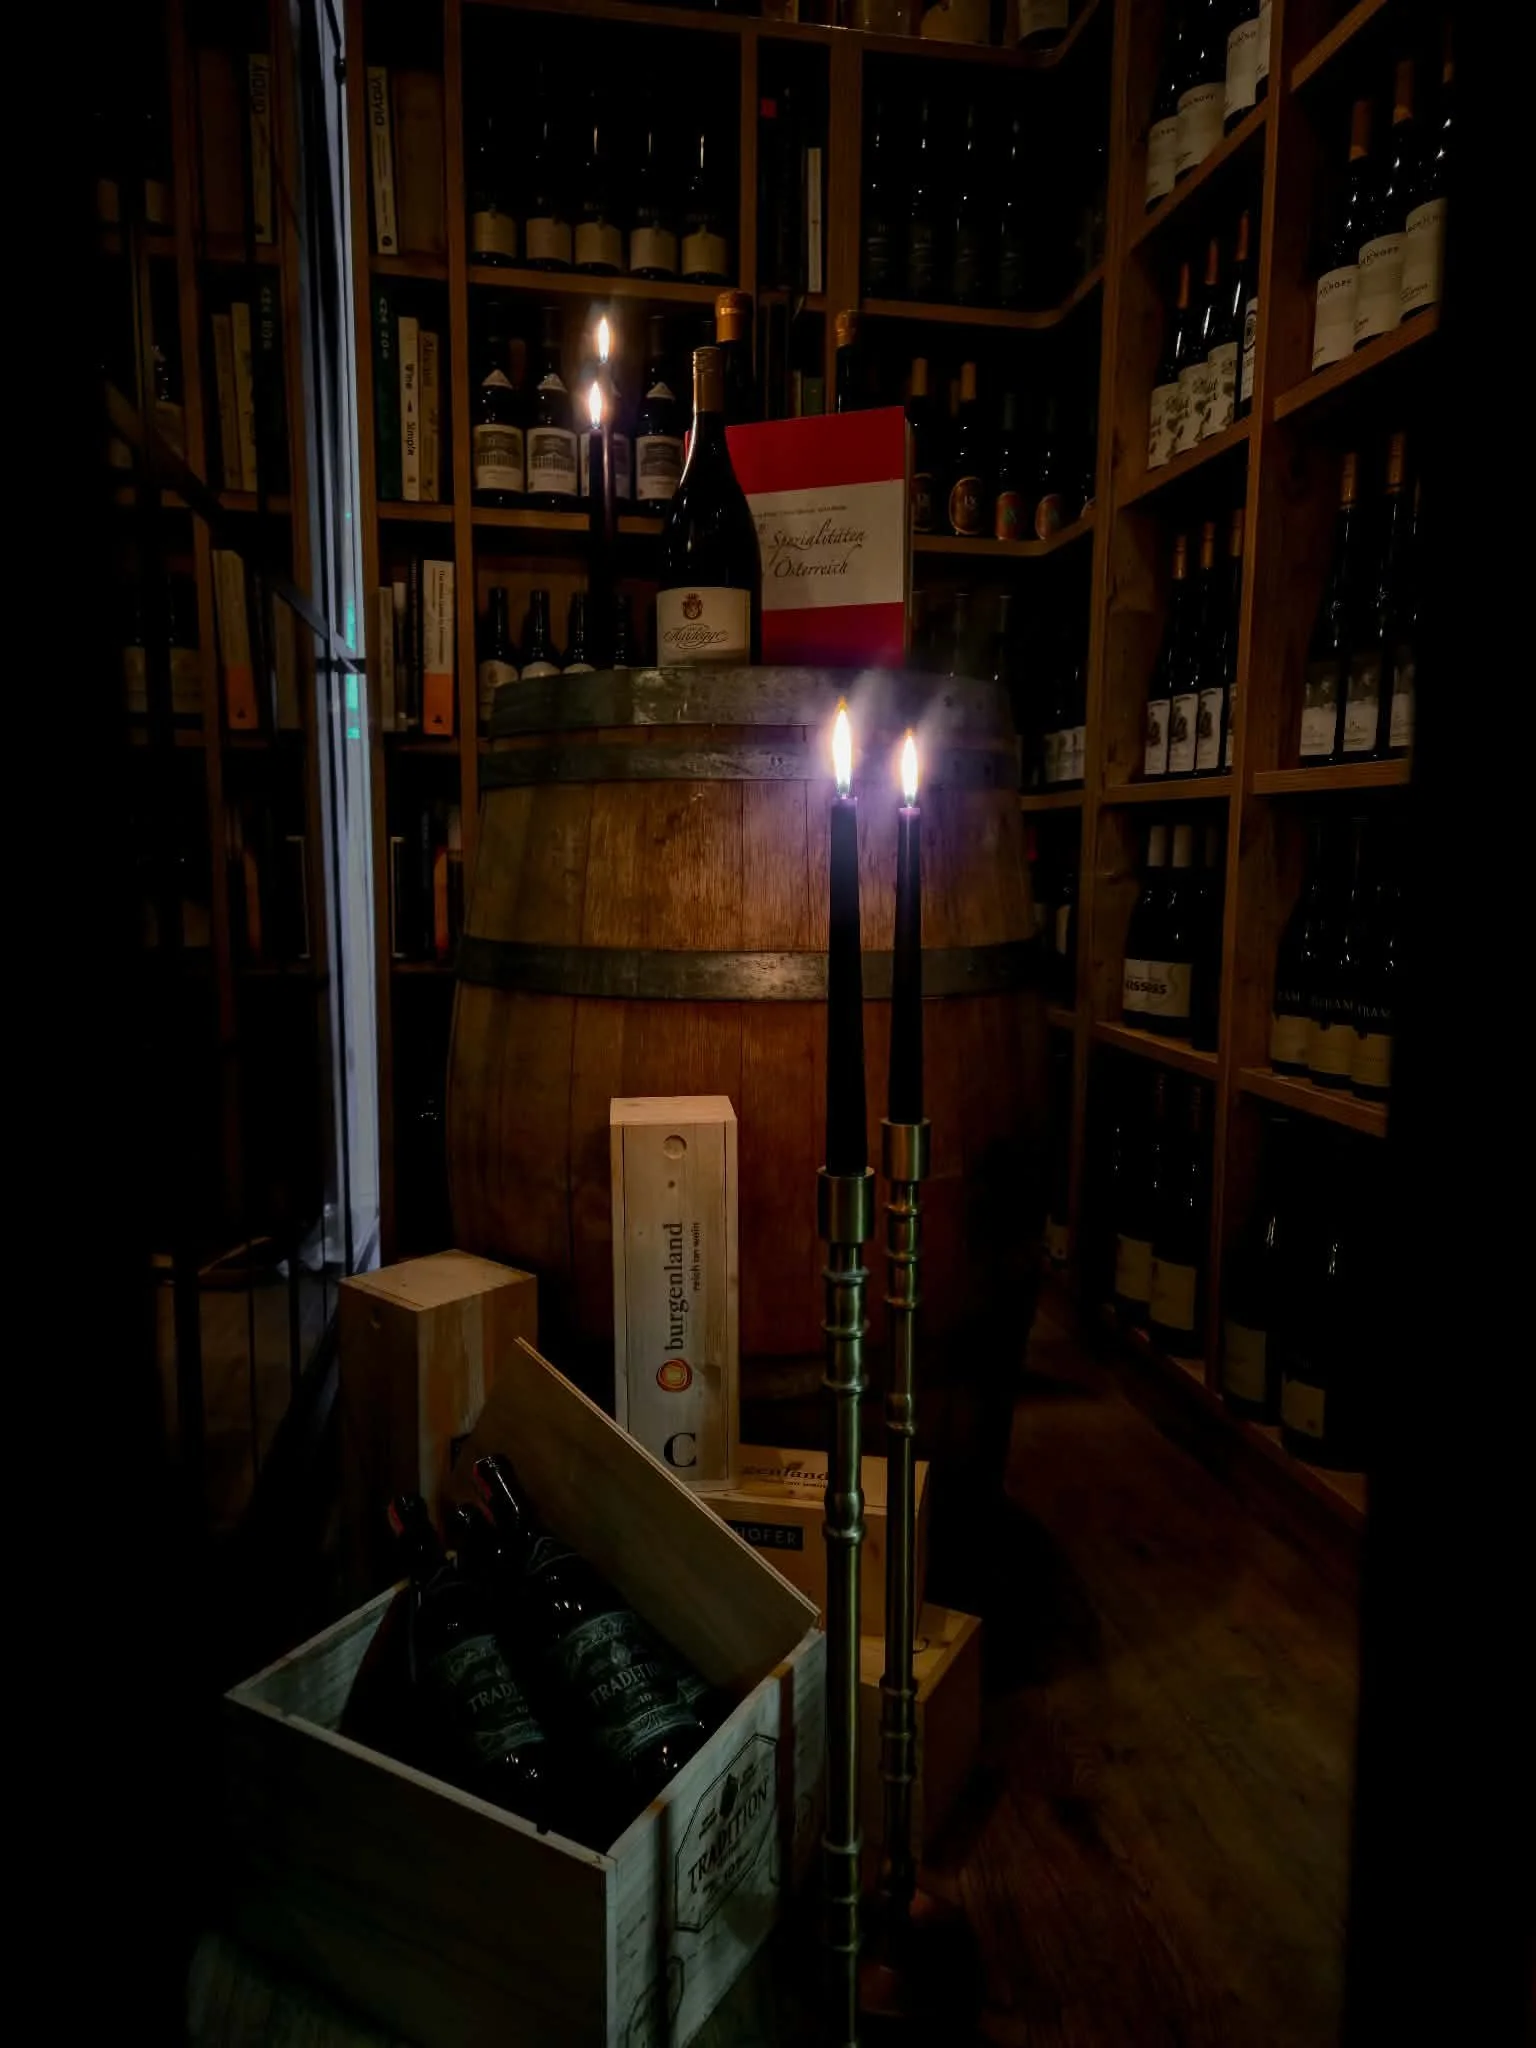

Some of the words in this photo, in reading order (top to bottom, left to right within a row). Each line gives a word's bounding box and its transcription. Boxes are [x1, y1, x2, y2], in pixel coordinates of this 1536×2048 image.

[768, 517, 865, 566] Spezialitäten
[773, 553, 850, 578] Österreich
[663, 1222, 690, 1351] burgenland
[687, 1776, 769, 1895] TRADITION
